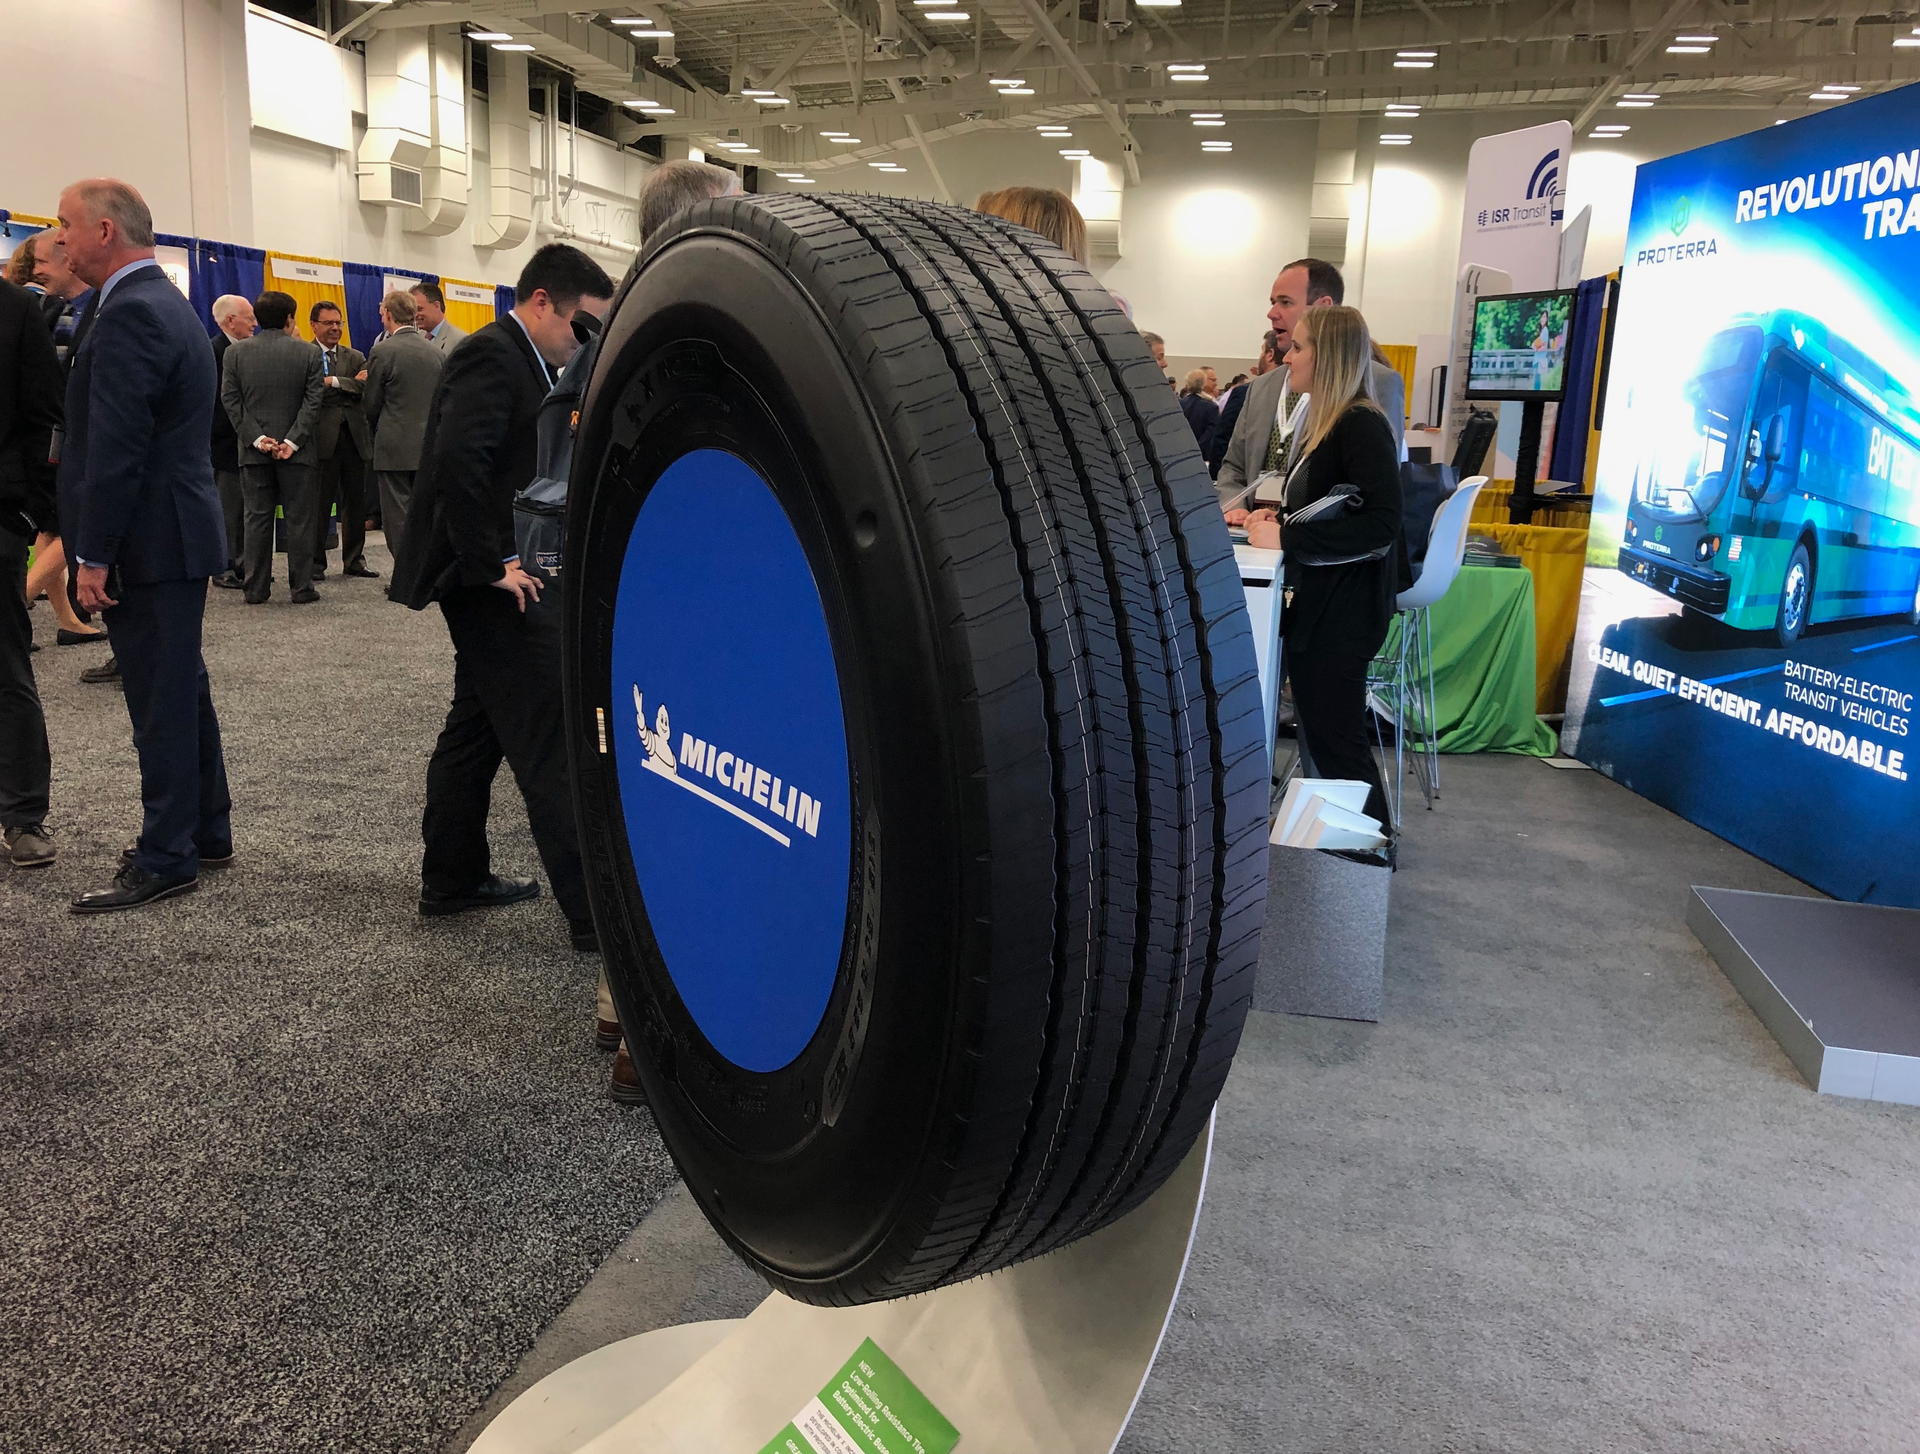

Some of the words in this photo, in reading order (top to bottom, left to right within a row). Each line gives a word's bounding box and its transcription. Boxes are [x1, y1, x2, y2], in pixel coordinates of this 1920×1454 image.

[1491, 208, 1510, 223] ISR
[1513, 203, 1547, 221] Transit
[1735, 149, 1920, 224] REVOLUTION
[1637, 238, 1717, 267] PROTERRA
[1588, 643, 1631, 677] CLEAN.
[1633, 659, 1676, 694] QUIET.
[1678, 675, 1762, 727] EFFICIENT.
[1764, 708, 1908, 782] AFFORDABLE.
[1784, 659, 1914, 713] BATTERY-ELECTRIC
[1784, 681, 1838, 714] TRANSIT
[1840, 701, 1909, 737] VEHICLES
[679, 732, 822, 839] MICHELIN
[858, 1359, 876, 1378] NEW
[832, 1389, 876, 1441] Battery-Electric
[873, 1437, 890, 1454] Buse
[841, 1380, 873, 1415] Optimized
[868, 1411, 880, 1424] for
[850, 1370, 883, 1410] Low-Rolling
[881, 1405, 913, 1442] Resistance
[911, 1438, 926, 1454] Tire
